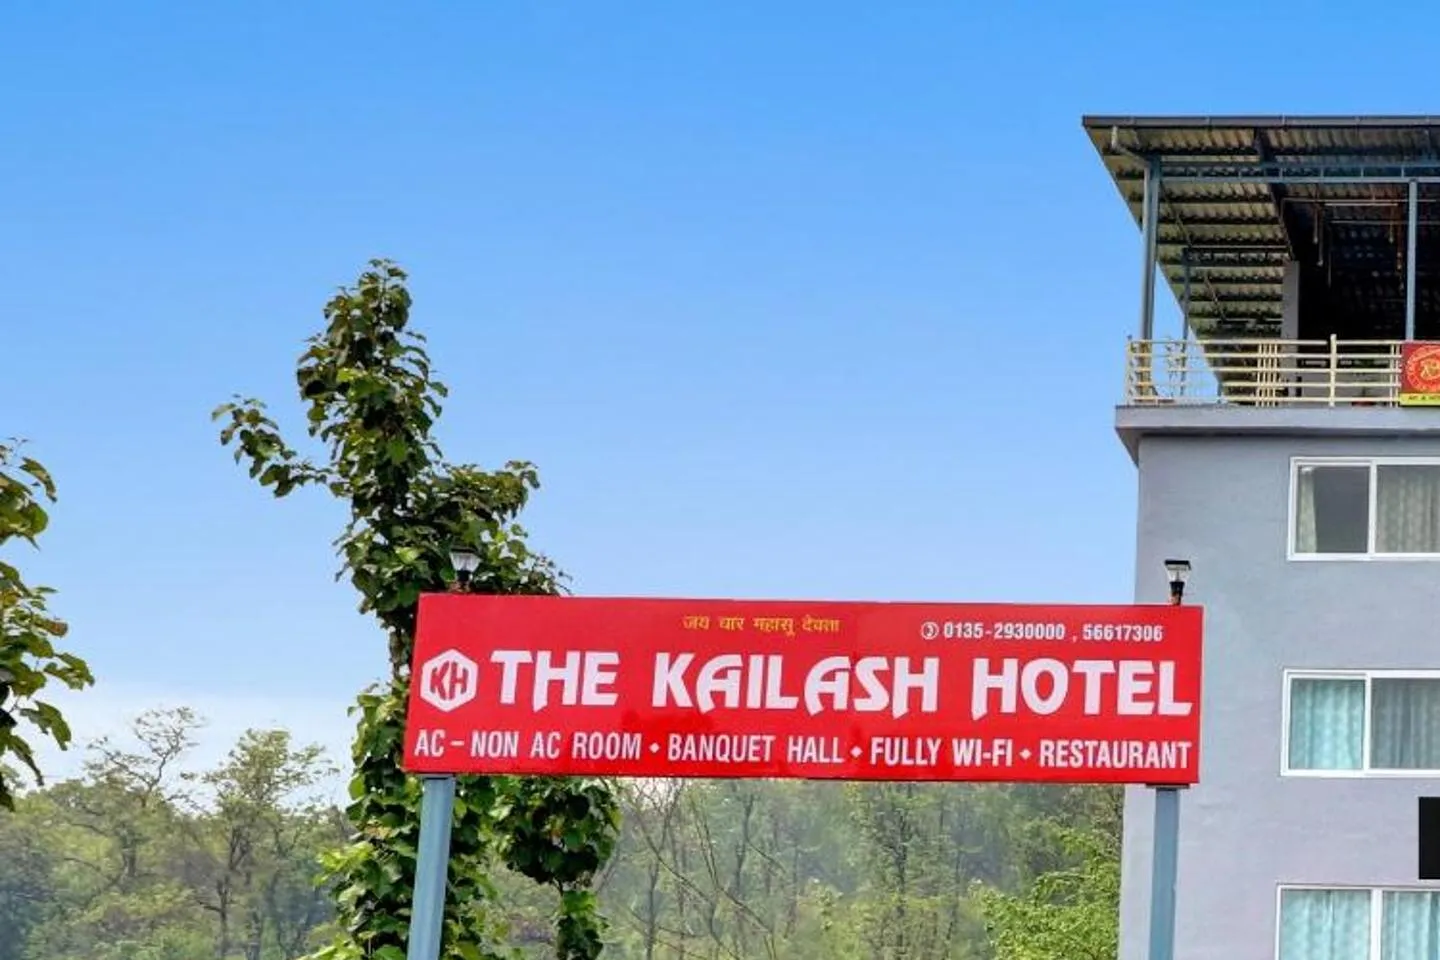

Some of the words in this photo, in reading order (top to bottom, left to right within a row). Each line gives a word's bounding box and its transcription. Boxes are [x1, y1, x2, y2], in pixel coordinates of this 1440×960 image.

[683, 614, 710, 631] जय
[1082, 624, 1163, 642] 56617306
[427, 658, 472, 703] KH
[490, 650, 620, 713] THE
[652, 652, 940, 719] KAILASH
[971, 657, 1193, 720] HOTEL
[530, 731, 562, 760] AC
[572, 732, 642, 761] ROOM
[668, 733, 776, 764] BANQUET
[787, 735, 844, 764] HALL
[870, 736, 942, 766] FULLY
[952, 738, 1013, 768] WI-FI
[1039, 740, 1192, 769] RESTAURANT
